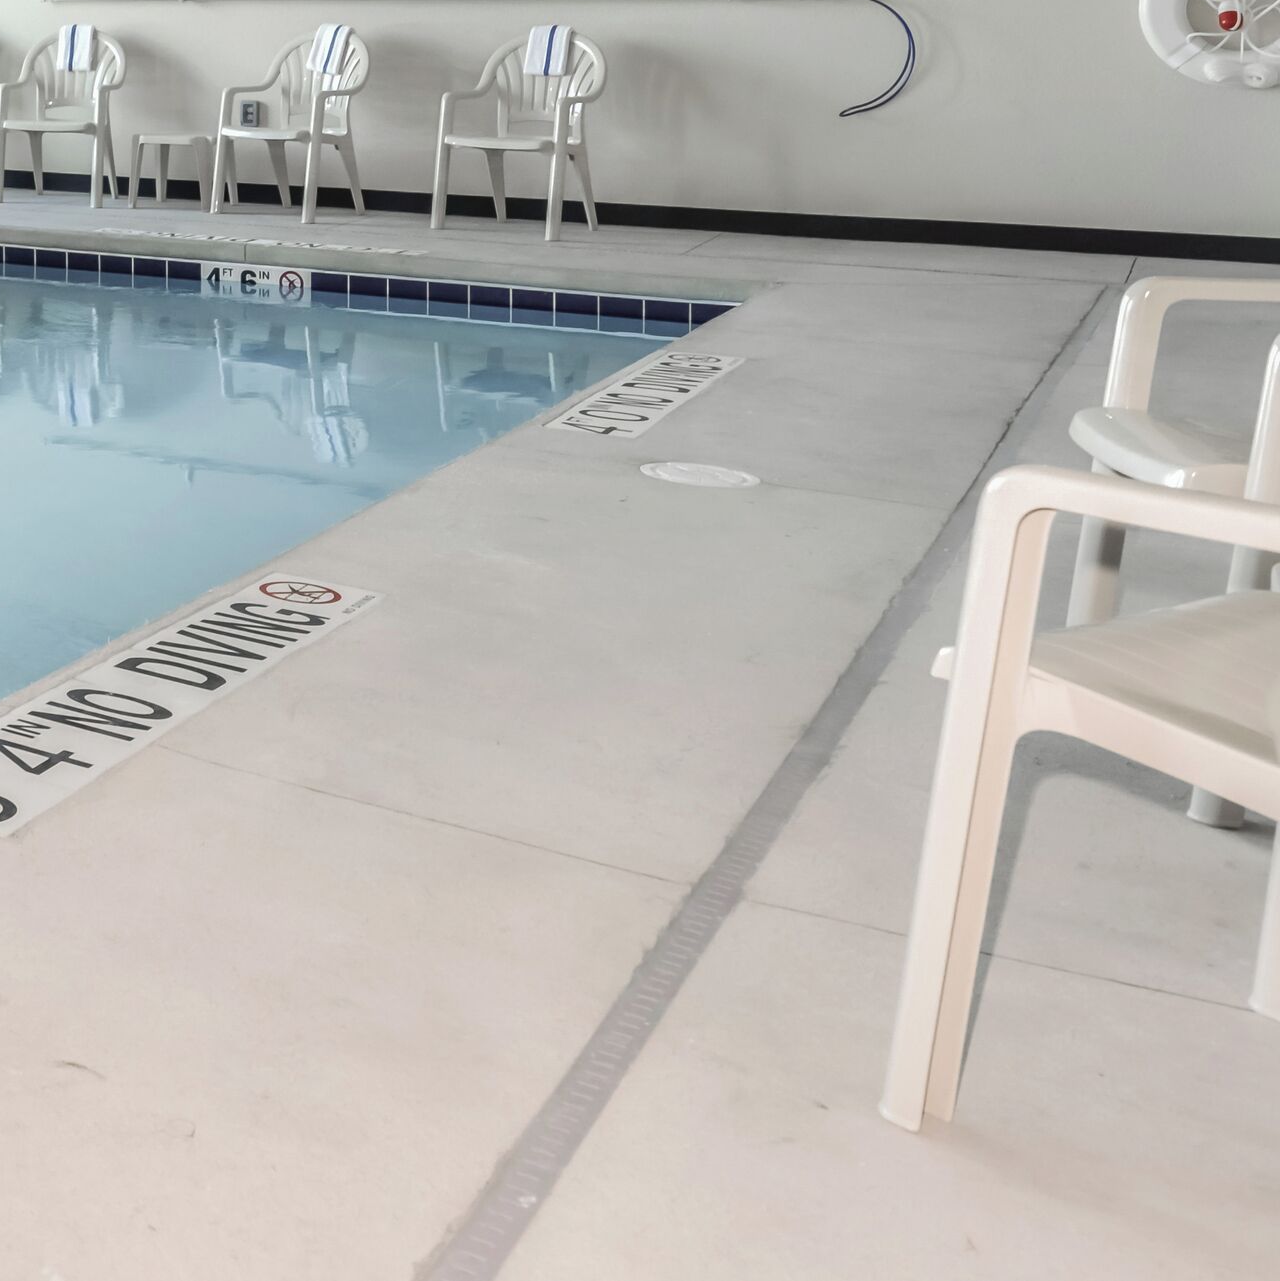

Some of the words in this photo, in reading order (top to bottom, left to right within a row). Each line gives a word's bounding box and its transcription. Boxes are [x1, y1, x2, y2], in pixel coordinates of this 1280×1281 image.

[222, 268, 233, 277] FT
[241, 270, 257, 285] 6
[259, 271, 270, 280] IN
[621, 362, 723, 393] DIVING
[595, 393, 674, 410] NO
[561, 421, 633, 434] 4
[0, 718, 51, 739] IN
[28, 688, 173, 742] NO
[114, 602, 331, 691] DIVING
